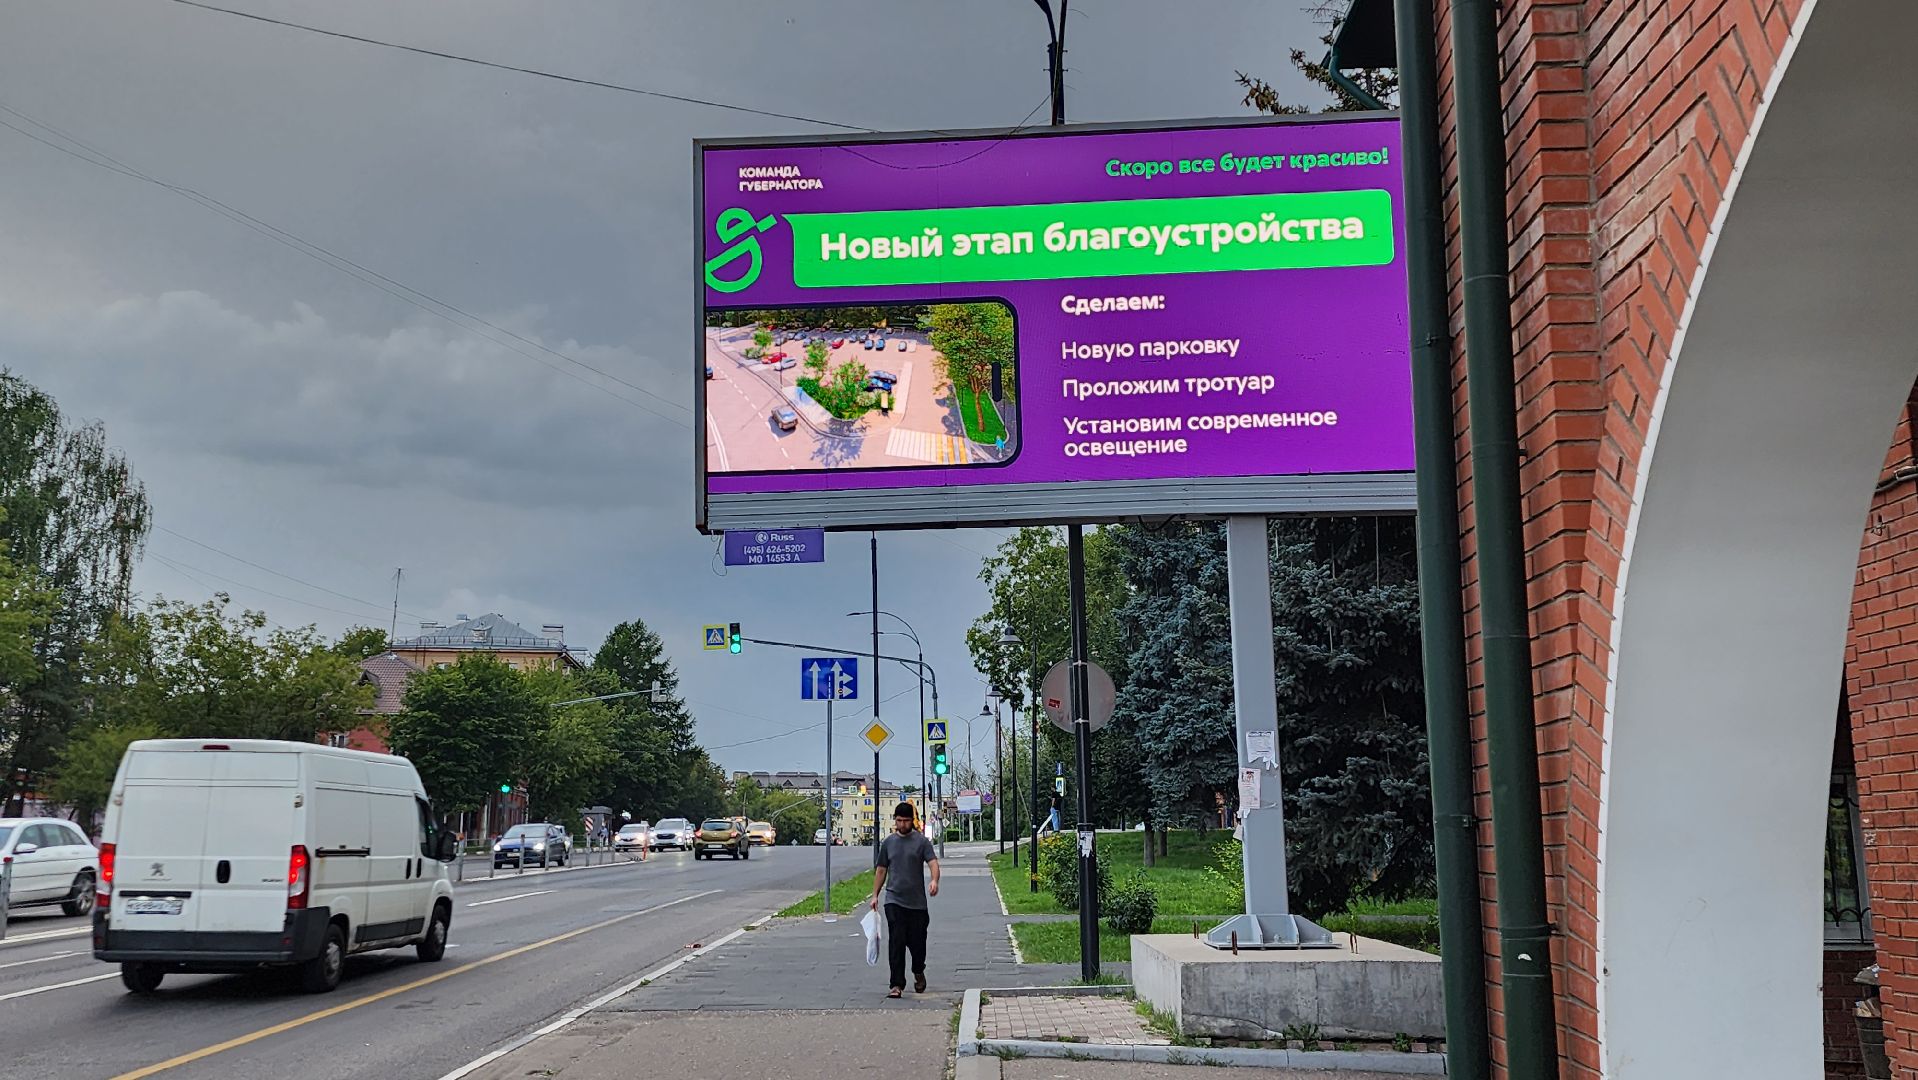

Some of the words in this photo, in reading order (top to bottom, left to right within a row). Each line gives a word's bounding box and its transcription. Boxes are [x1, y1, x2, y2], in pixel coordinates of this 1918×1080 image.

[739, 166, 801, 178] КОМАНДА
[1105, 159, 1173, 179] Скоро
[1179, 159, 1215, 174] все
[1220, 153, 1285, 176] будет
[1290, 147, 1388, 173] красиво!
[739, 179, 824, 192] ГУБЕРНАТОРА
[820, 228, 943, 261] Новый
[952, 231, 1034, 256] этап
[1043, 212, 1364, 256] благоустройства
[1061, 295, 1165, 316] Сделаем:
[1061, 341, 1134, 362] Новую
[1139, 338, 1240, 360] парковку
[1062, 378, 1180, 400] Проложим
[1184, 374, 1275, 397] тротуар
[1063, 415, 1182, 435] Установим
[1187, 411, 1338, 434] современное
[1064, 437, 1188, 457] освещение
[770, 533, 794, 541] Russ
[744, 545, 764, 555] (495)
[766, 544, 806, 554] 626-5202
[766, 553, 791, 563] 14553
